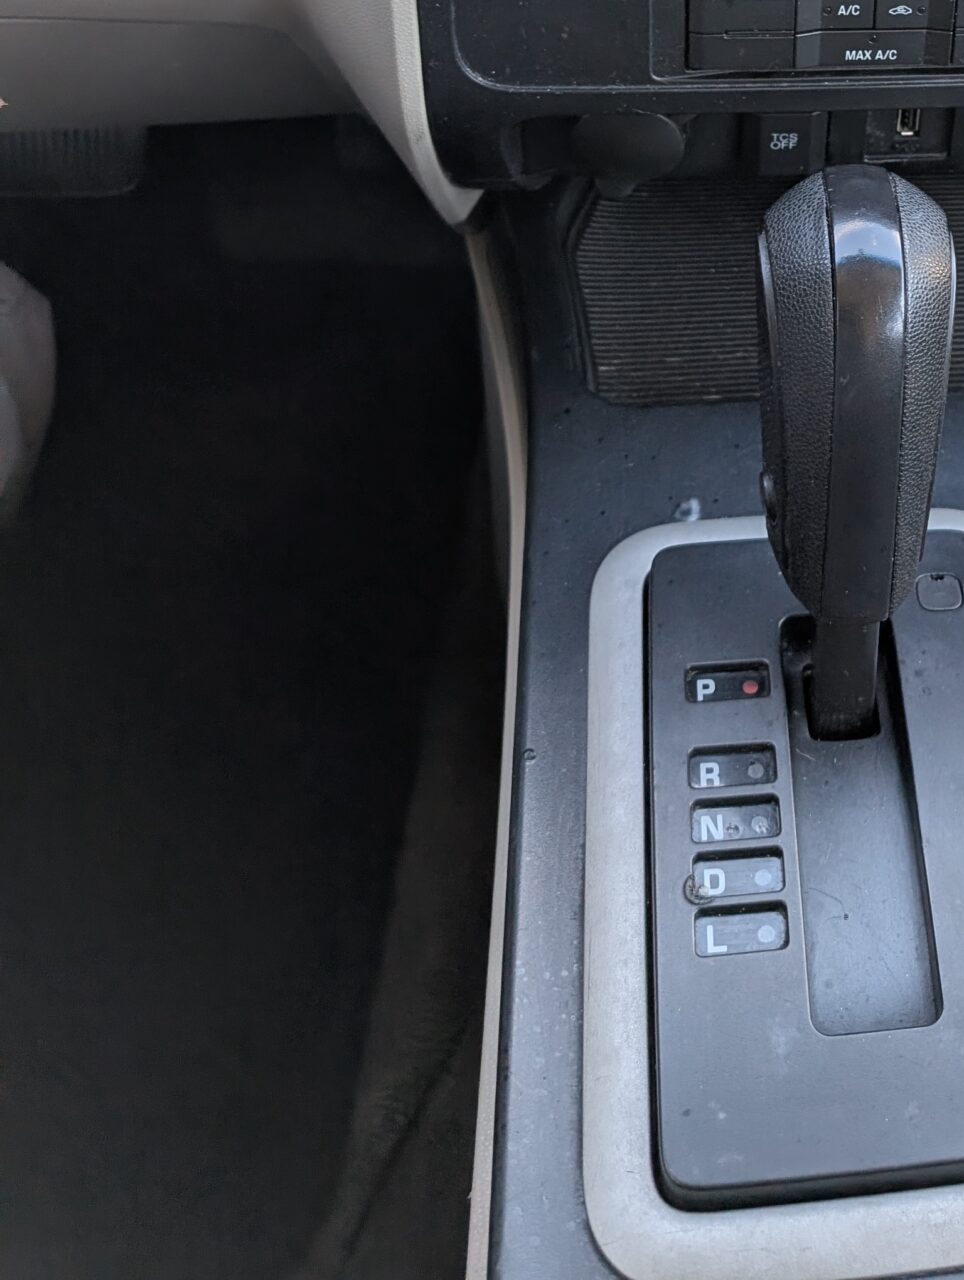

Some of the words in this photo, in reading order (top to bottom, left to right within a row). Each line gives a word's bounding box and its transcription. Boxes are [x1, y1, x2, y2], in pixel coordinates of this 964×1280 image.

[837, 4, 860, 16] A/C
[845, 49, 873, 61] MAX
[874, 49, 898, 60] A/C
[770, 132, 798, 142] TCS
[770, 140, 798, 150] OFF
[696, 678, 716, 702] P
[699, 762, 721, 788] R
[700, 814, 724, 841] N
[703, 868, 726, 896] D
[706, 924, 728, 954] L
